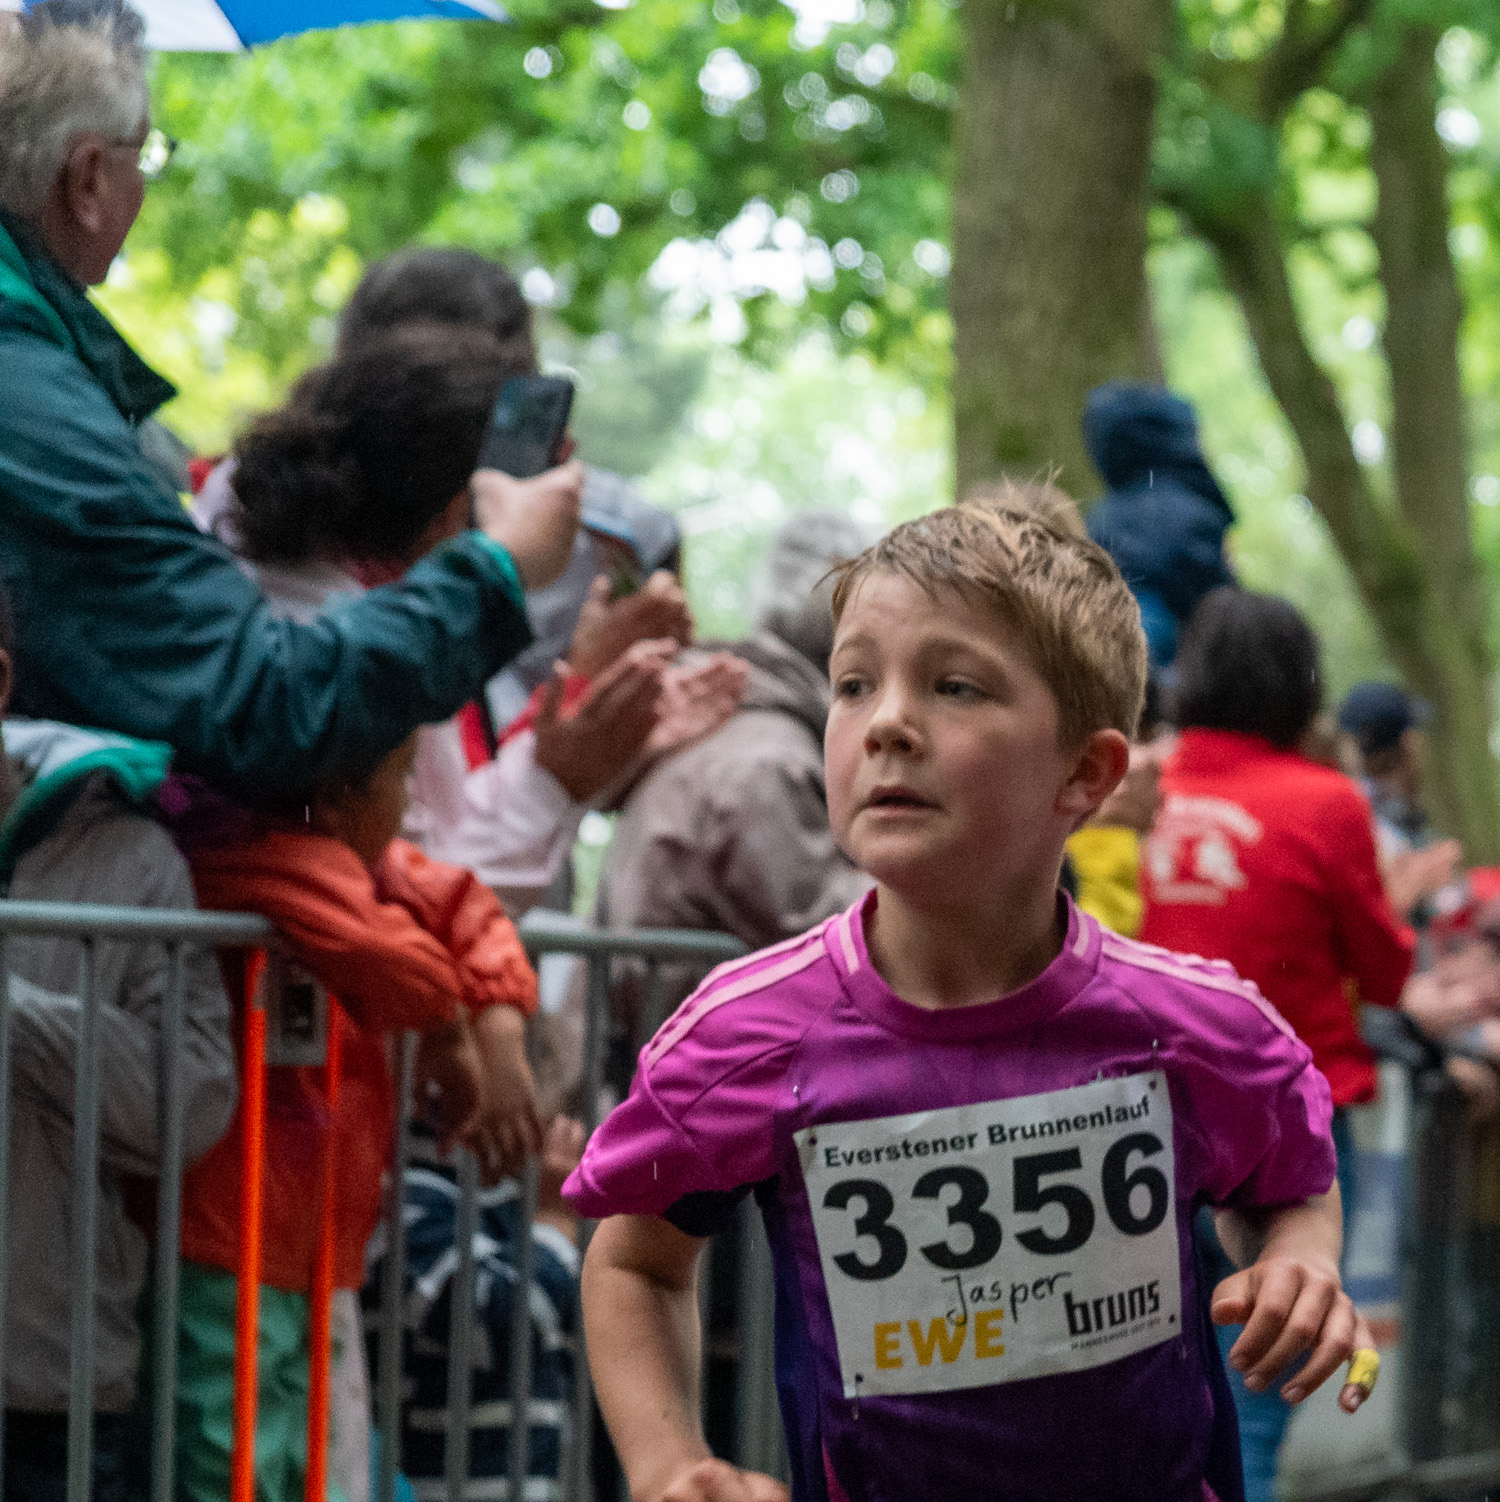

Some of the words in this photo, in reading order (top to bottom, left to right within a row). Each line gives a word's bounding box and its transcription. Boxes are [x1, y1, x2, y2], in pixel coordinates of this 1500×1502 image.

[825, 1130, 979, 1168] Everstener
[987, 1096, 1151, 1146] Brunnenlauf
[822, 1131, 1169, 1282] 3356
[941, 1271, 1073, 1327] Jasper
[1064, 1280, 1160, 1336] bruns
[873, 1308, 1005, 1370] EWE
